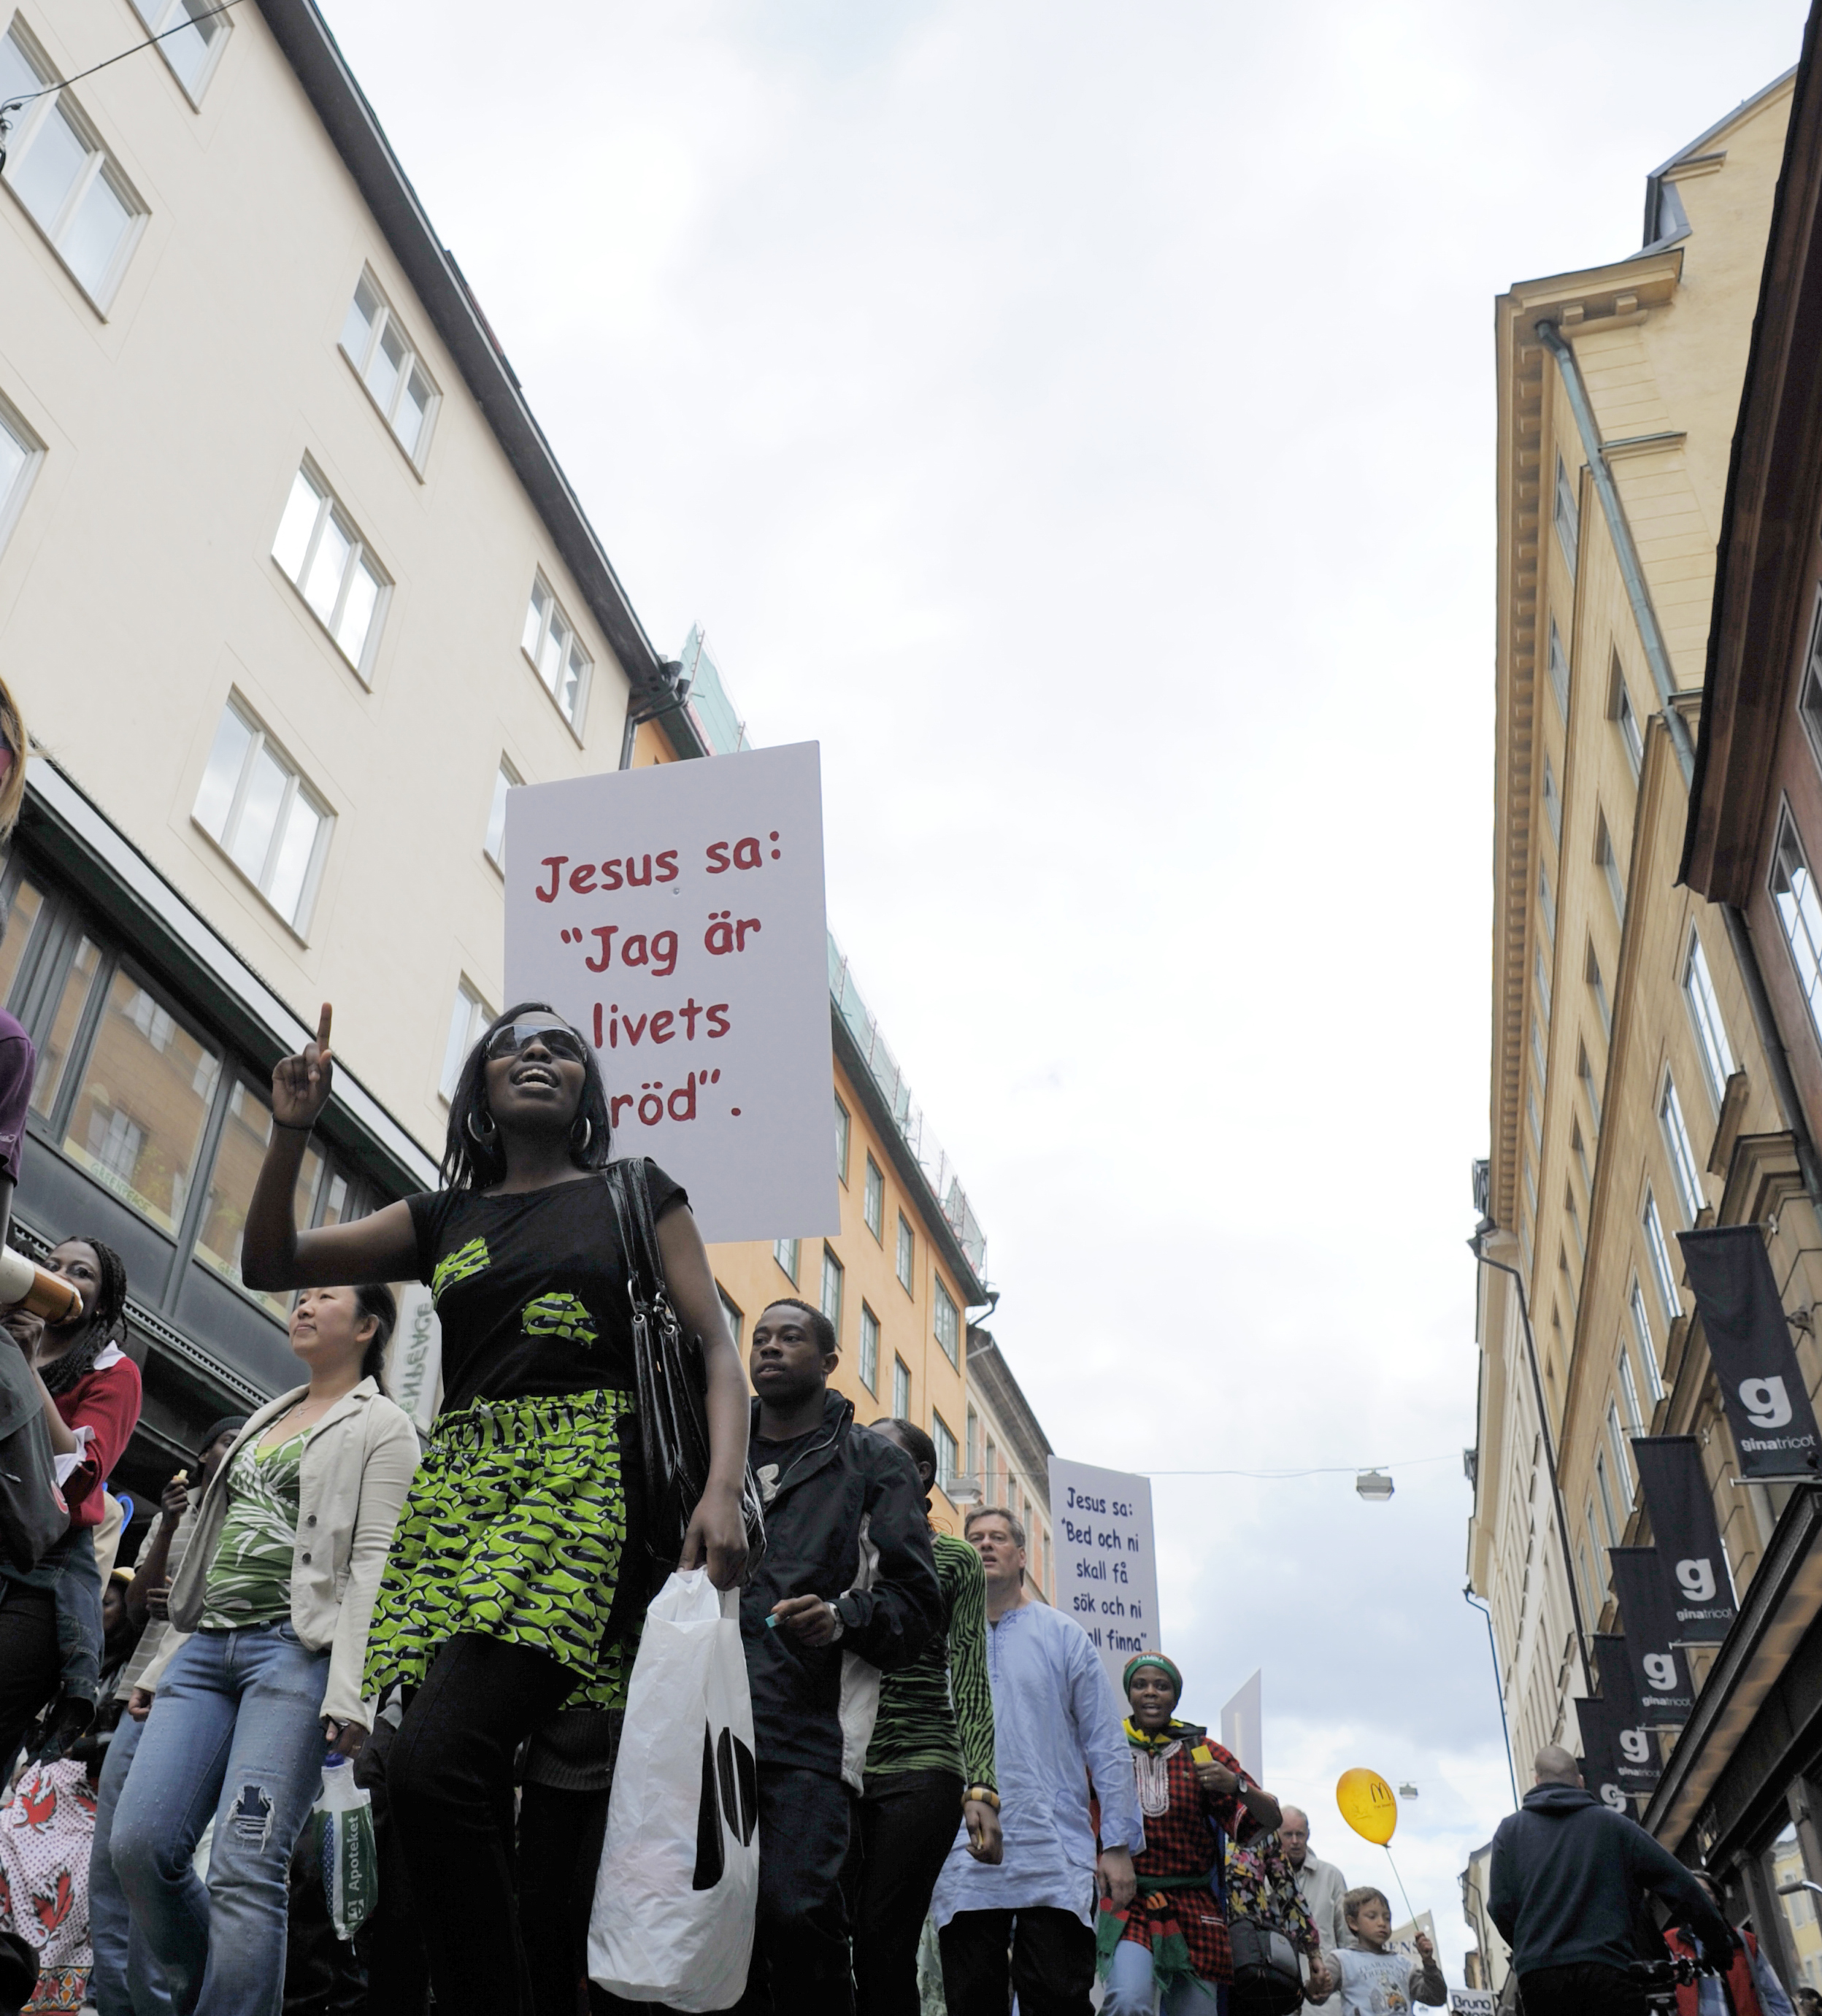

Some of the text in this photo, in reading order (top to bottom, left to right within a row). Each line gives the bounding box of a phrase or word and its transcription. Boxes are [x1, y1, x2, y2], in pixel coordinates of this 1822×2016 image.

[535, 830, 781, 903] Jesus sa:
[561, 910, 761, 977] "Jag är
[592, 997, 731, 1050] livets
[1738, 1375, 1793, 1429] g
[1740, 1434, 1817, 1453] ginatricot
[1066, 1486, 1133, 1517] Jesus sa:
[1061, 1517, 1139, 1553] "Bed och ni
[1076, 1558, 1129, 1584] skall få
[1675, 1558, 1717, 1602] g
[1073, 1592, 1142, 1619] sök och ni
[1676, 1608, 1733, 1622] ginatricot
[1643, 1653, 1678, 1691] g
[1642, 1695, 1692, 1707] ginatricot
[346, 1815, 363, 1891] Apoteket
